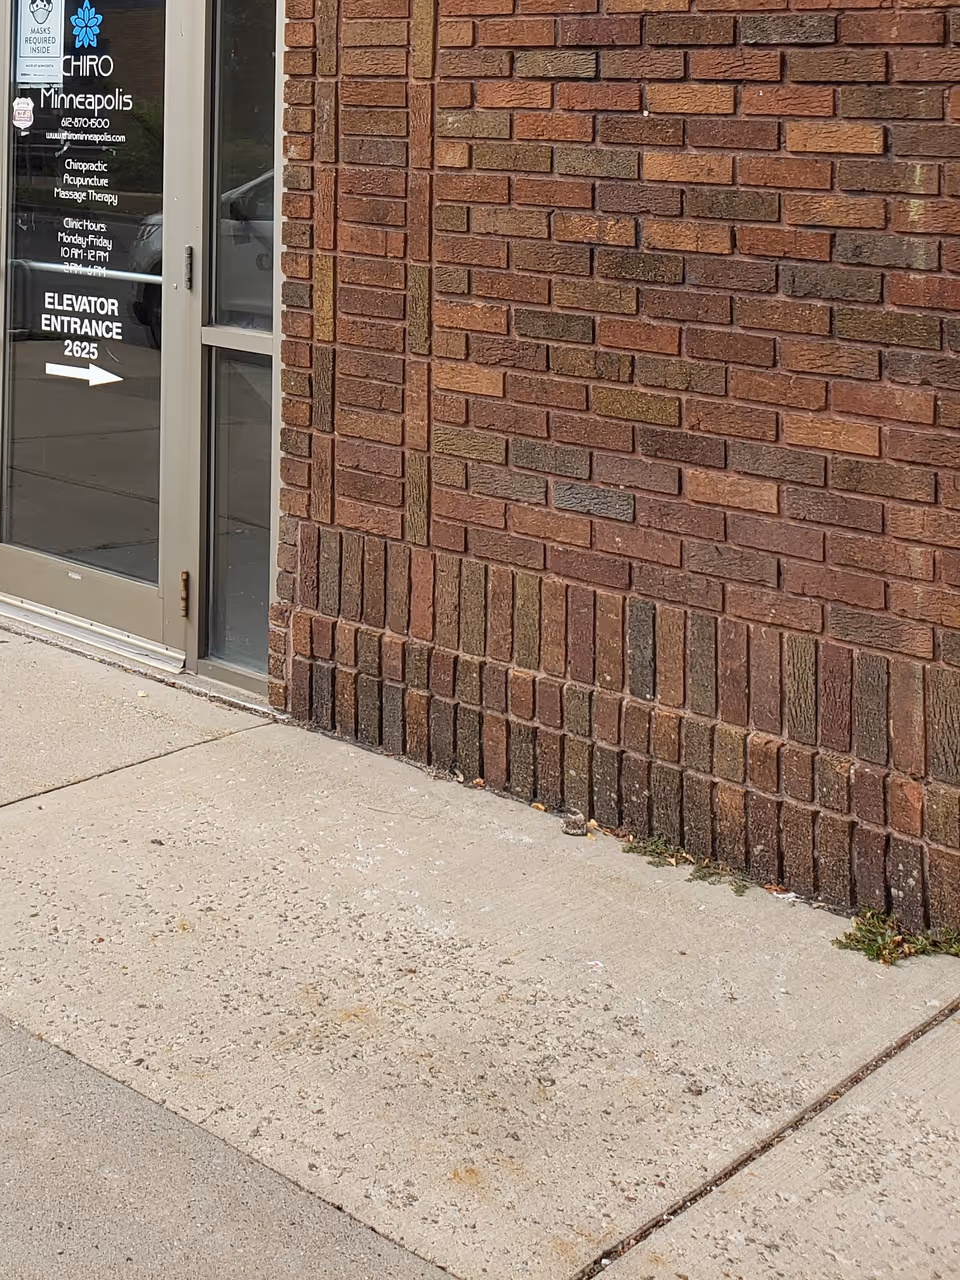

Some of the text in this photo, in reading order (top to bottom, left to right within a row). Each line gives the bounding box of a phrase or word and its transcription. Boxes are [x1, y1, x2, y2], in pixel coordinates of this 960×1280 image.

[30, 26, 51, 35] MASKS
[24, 36, 57, 45] REQUIRED
[29, 46, 51, 54] INSIDE
[61, 55, 114, 77] CHIRO
[40, 87, 133, 117] Minneapolis
[61, 117, 110, 129] 612-870-1500
[64, 158, 108, 174] Chiropractic
[63, 173, 109, 188] Acupuncture
[54, 187, 118, 206] Massage Therapy
[63, 217, 83, 229] Clinic
[60, 246, 70, 258] 10
[44, 291, 119, 317] ELEVATOR
[41, 313, 123, 340] ENTRANCE
[63, 339, 98, 360] 2625
